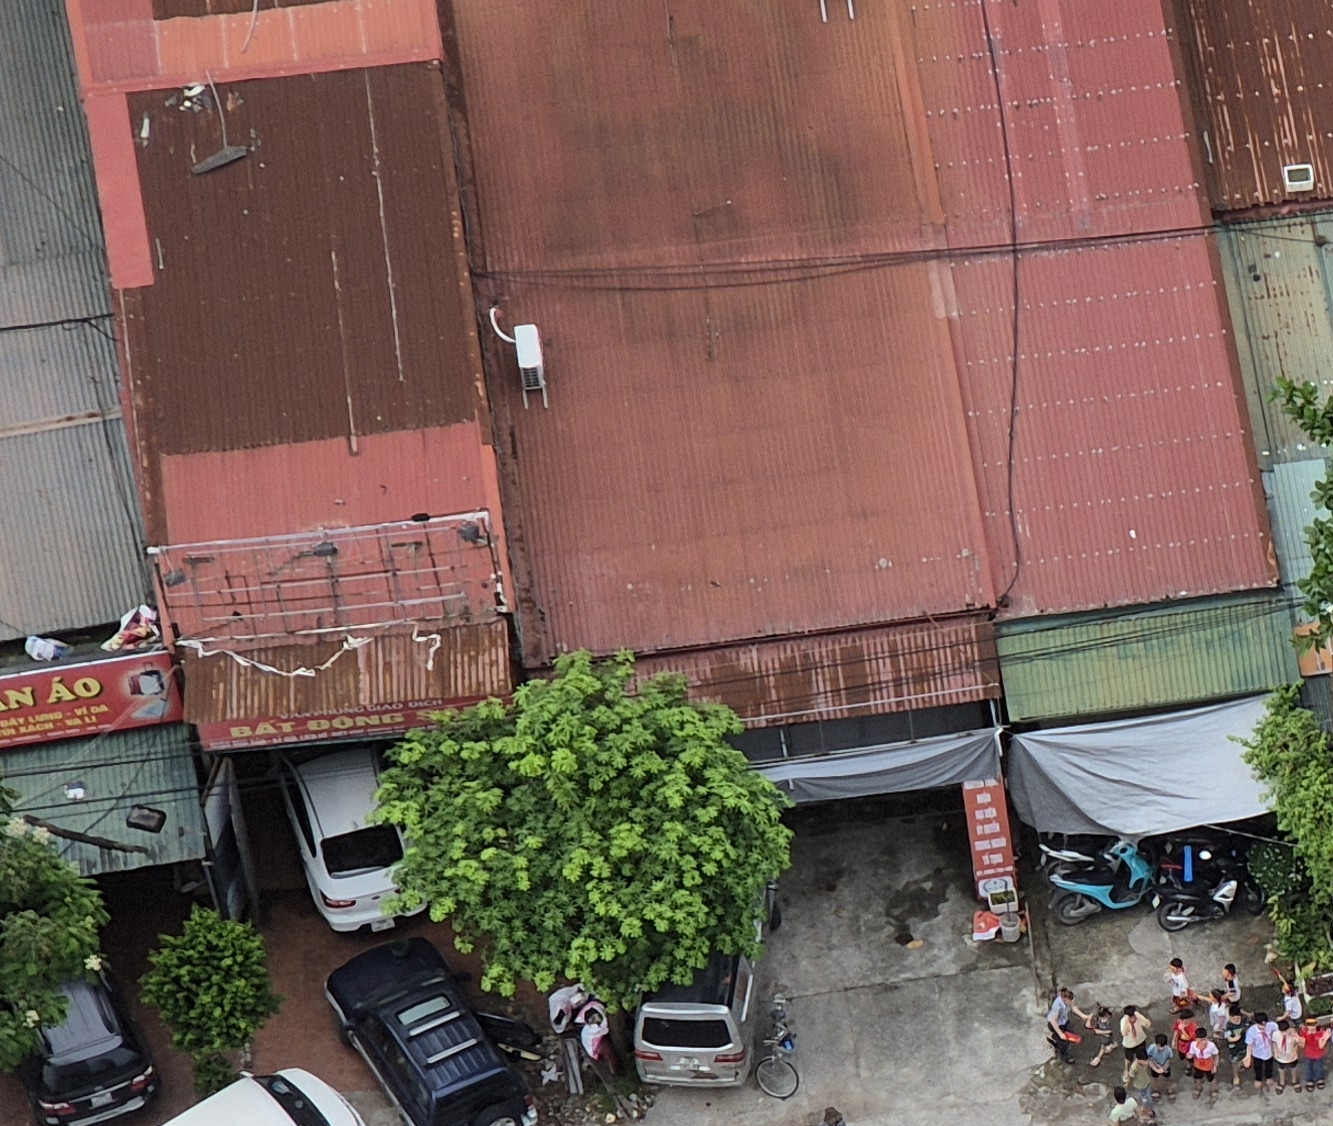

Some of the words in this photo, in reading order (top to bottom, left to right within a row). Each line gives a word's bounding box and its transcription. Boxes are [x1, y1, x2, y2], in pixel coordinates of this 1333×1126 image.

[47, 676, 101, 704] ÁO
[90, 704, 109, 714] DA
[229, 719, 296, 738] BẤT
[307, 712, 405, 731] ĐỘNG
